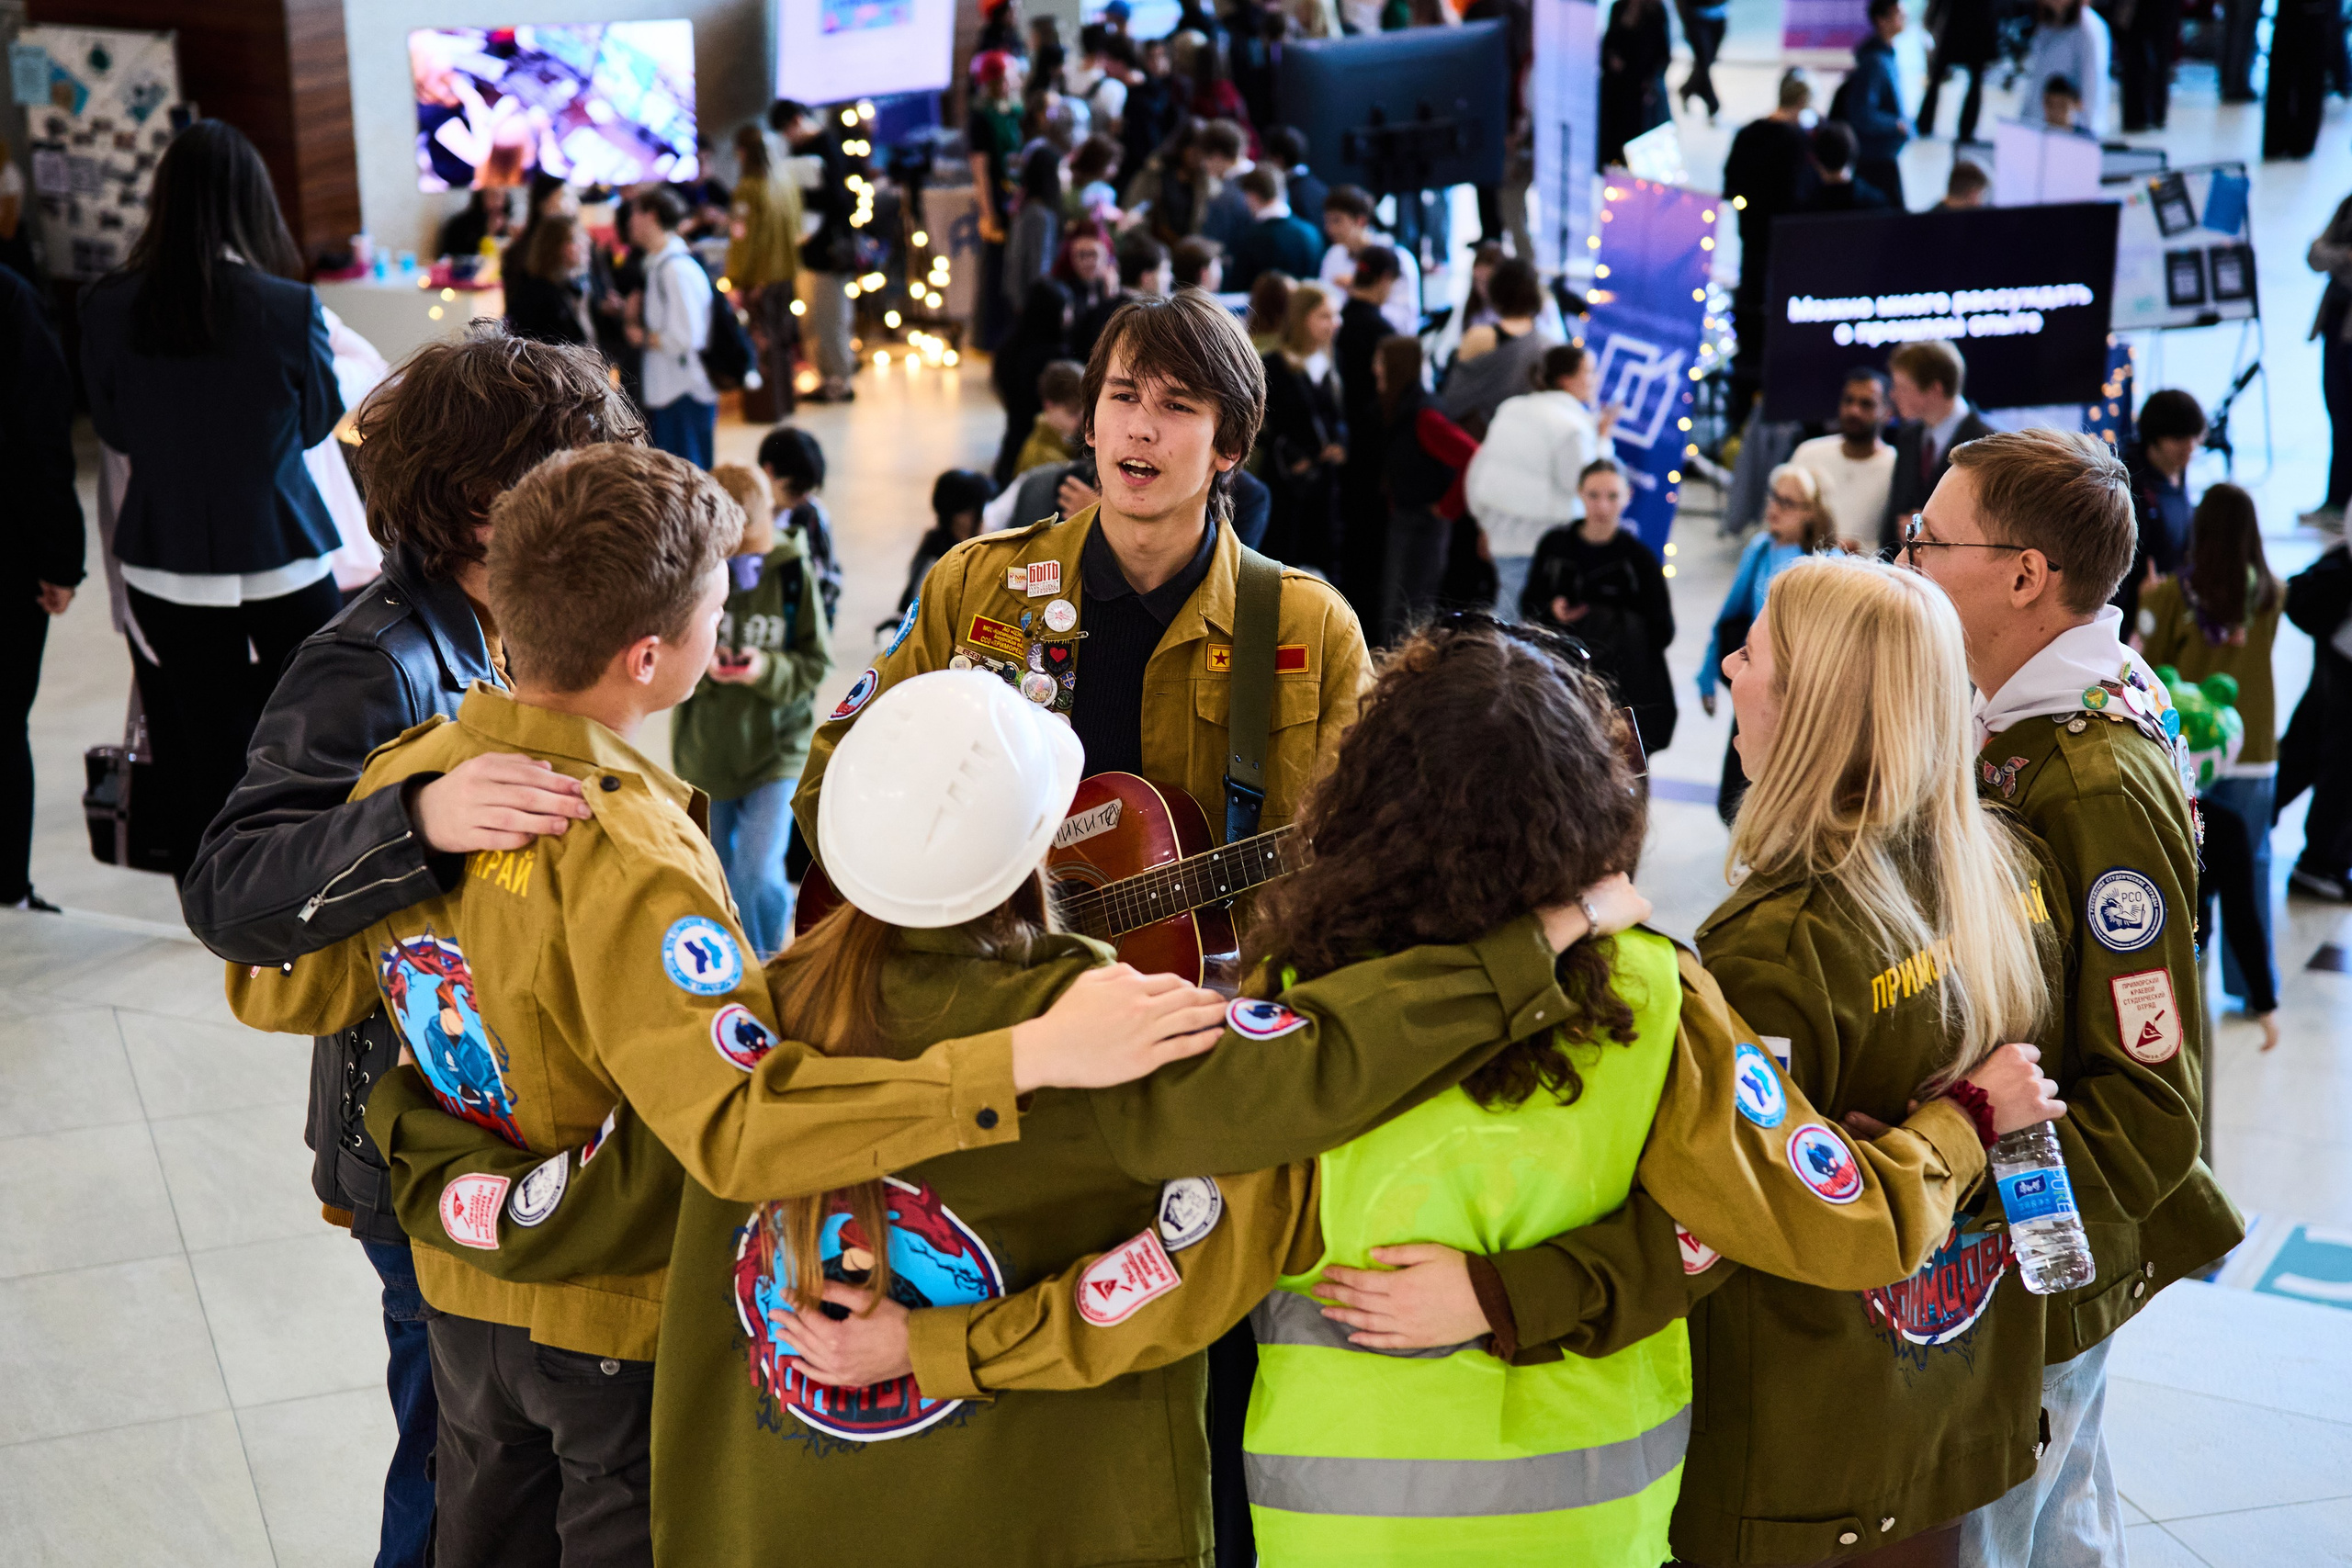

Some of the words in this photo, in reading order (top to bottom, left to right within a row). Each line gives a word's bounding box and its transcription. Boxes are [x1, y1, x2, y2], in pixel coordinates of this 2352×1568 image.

[1787, 295, 1875, 323] Можно
[1875, 291, 1951, 318] много
[1951, 283, 2094, 317] рассуждать
[1833, 322, 1854, 346] о
[1967, 310, 2044, 338] опыте
[1029, 562, 1058, 582] БЫТЬ
[2105, 874, 2145, 887] СТУДЕНЧЕСКИЕ
[2121, 891, 2142, 903] РСО
[2121, 976, 2159, 990] ПРИМОРСКИЙ
[2131, 986, 2155, 996] КРАЕВОЙ
[2122, 991, 2165, 1006] СТУДЕНЧЕСКИЙ
[2136, 1001, 2157, 1010] ОТРЯД
[2047, 1167, 2074, 1213] PURE
